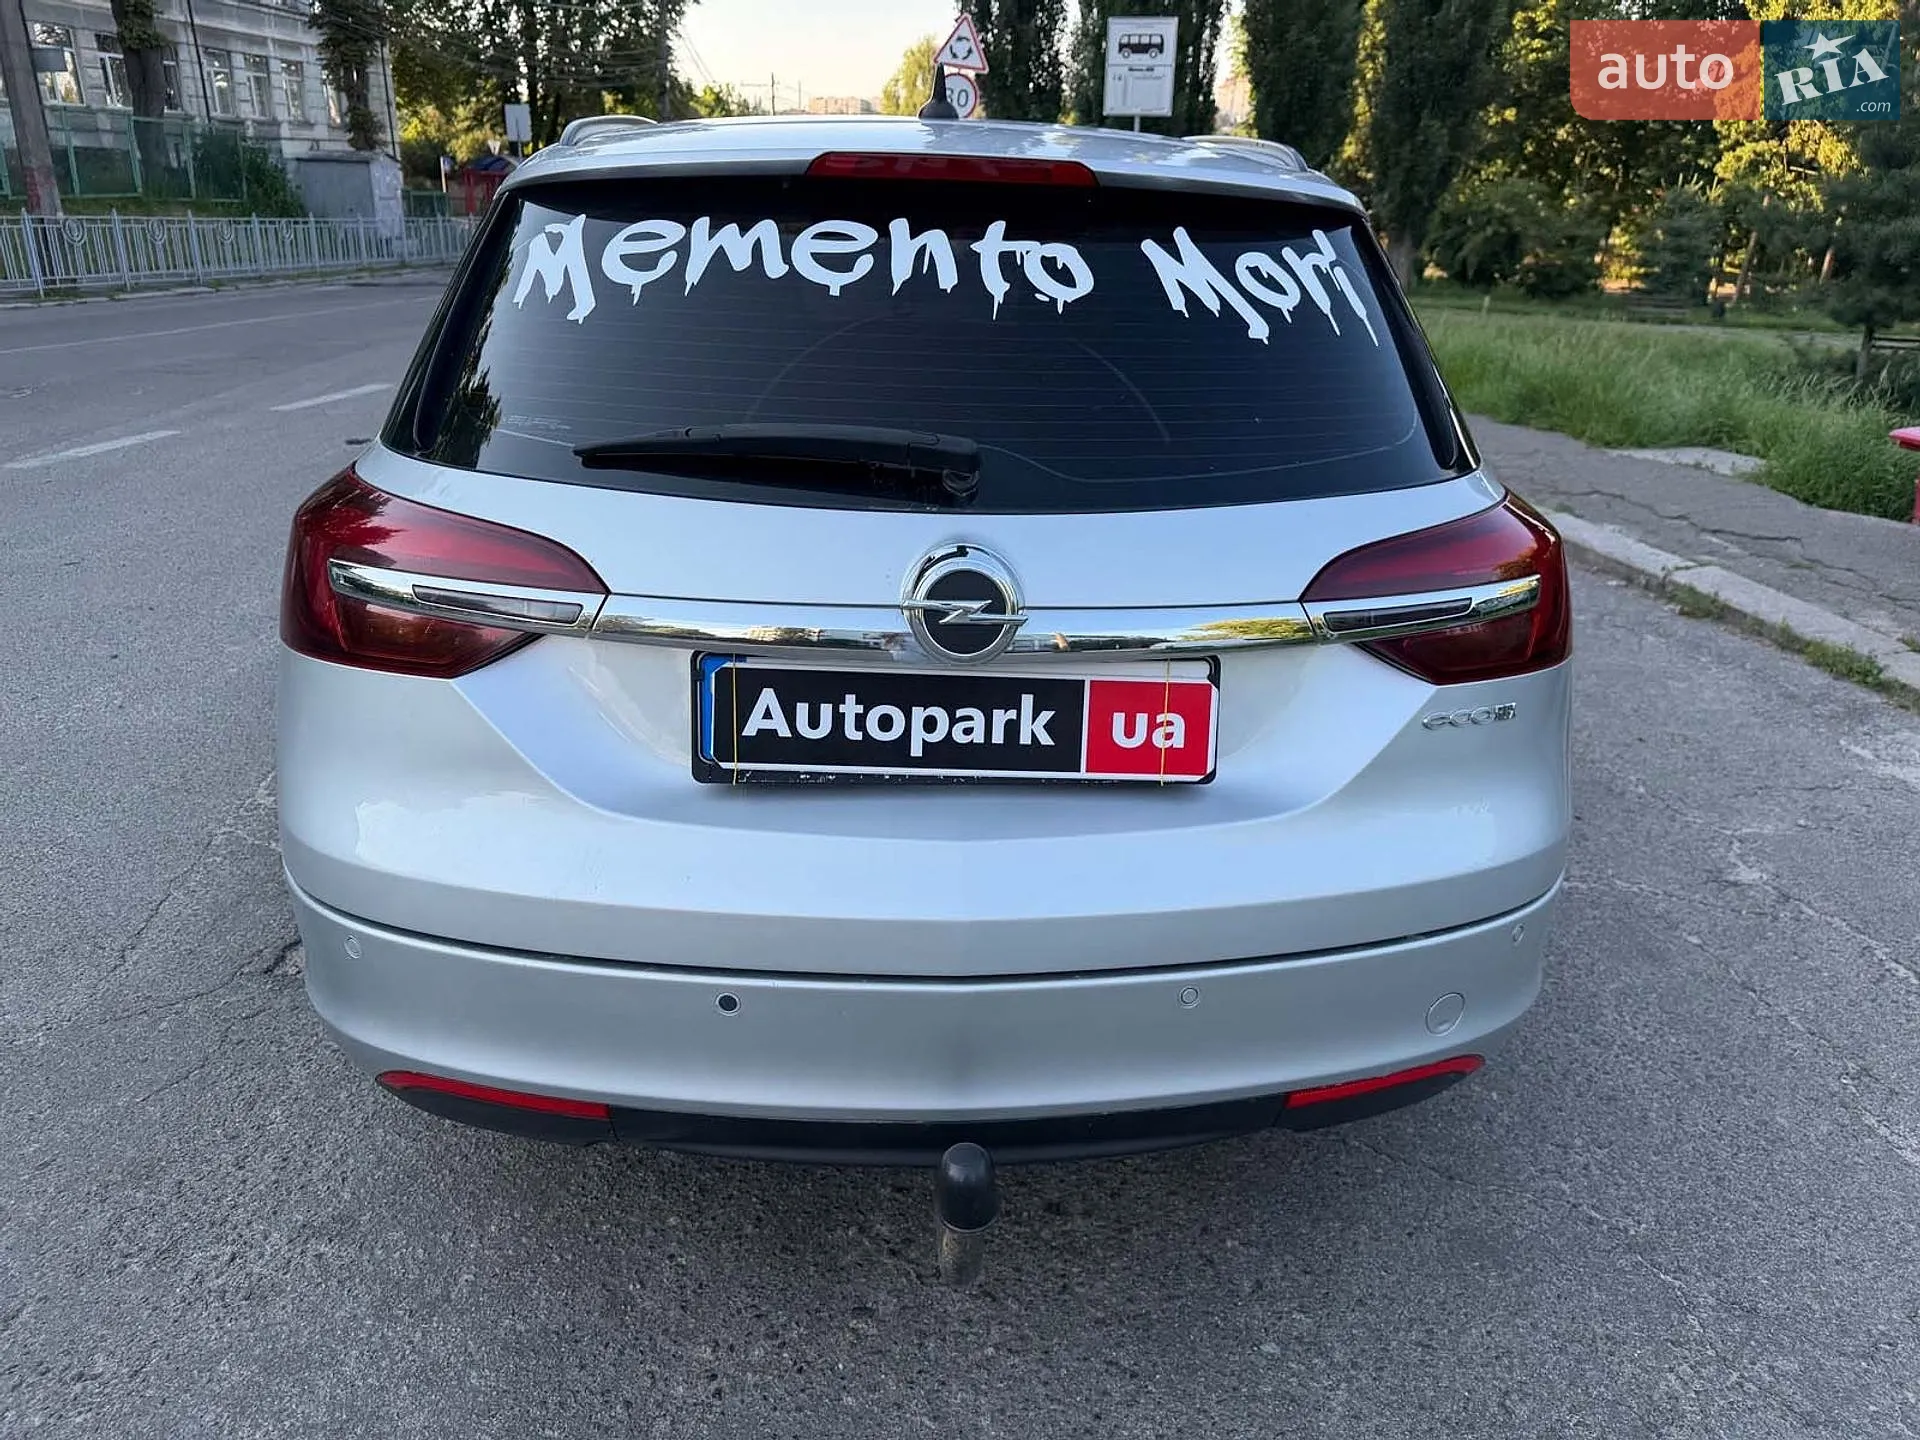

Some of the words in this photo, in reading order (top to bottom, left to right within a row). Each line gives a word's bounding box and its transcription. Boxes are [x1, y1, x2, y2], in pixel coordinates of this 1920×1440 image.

[512, 214, 1095, 325] Memento
[1141, 227, 1379, 347] Mori
[742, 687, 1056, 757] Autopark
[1112, 712, 1186, 750] ua
